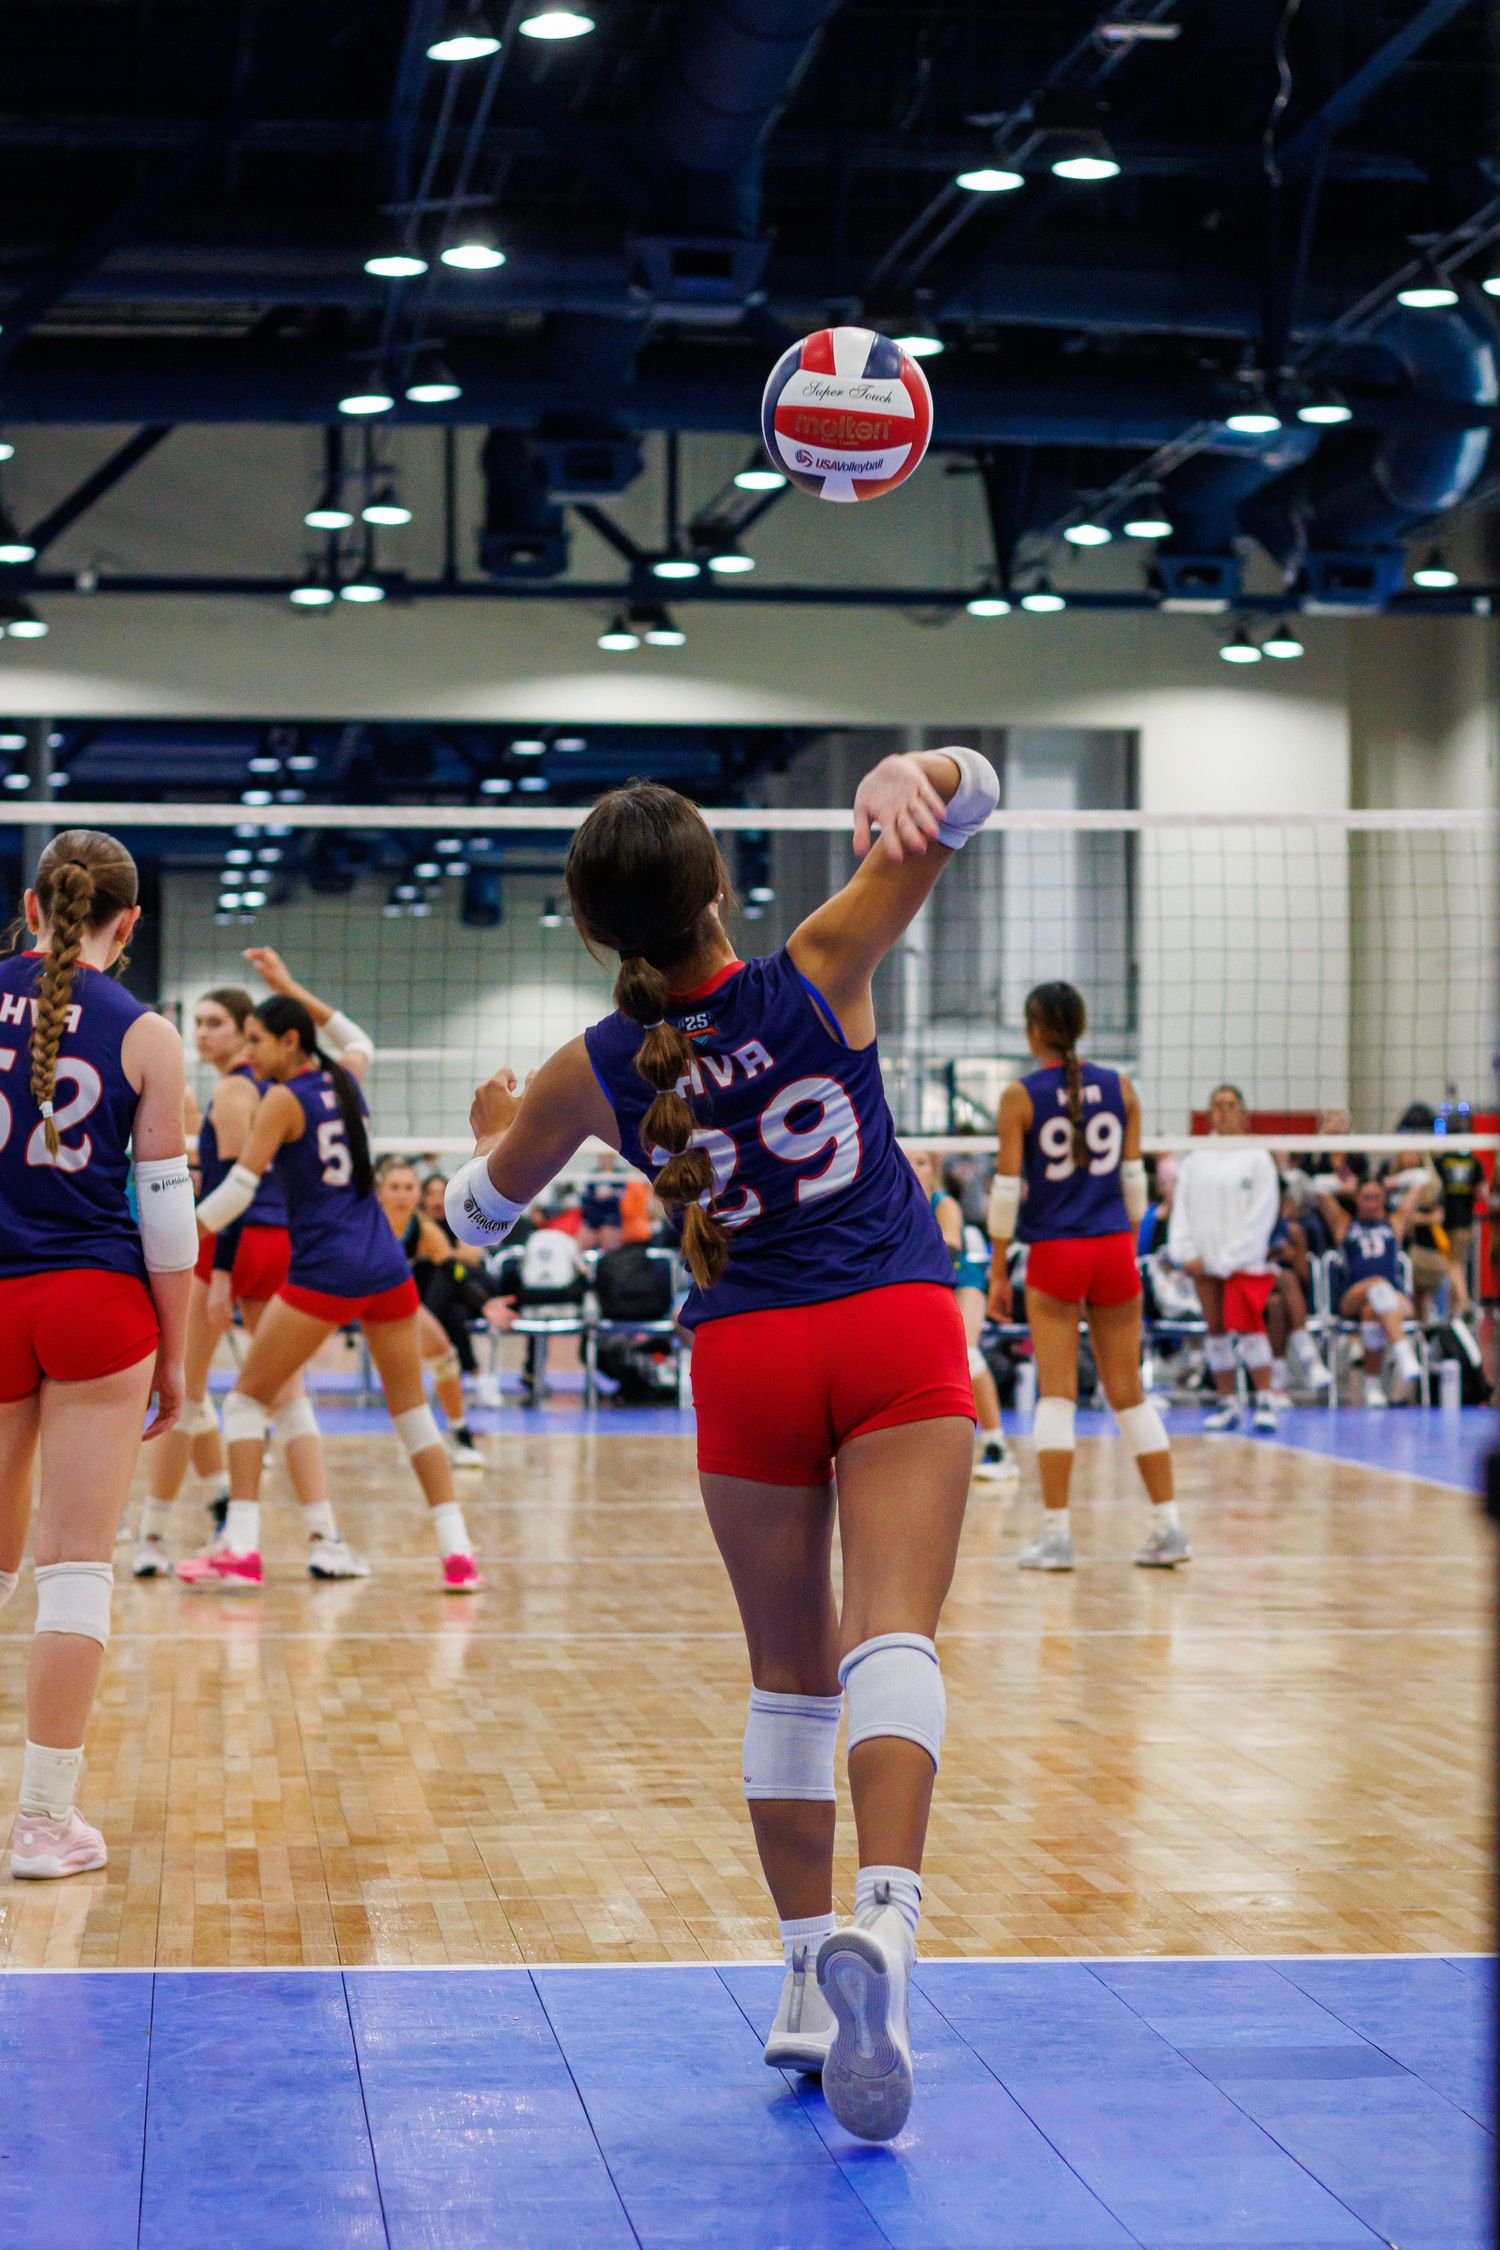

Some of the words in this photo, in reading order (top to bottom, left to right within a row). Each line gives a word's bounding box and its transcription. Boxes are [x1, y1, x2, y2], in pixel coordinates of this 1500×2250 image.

[802, 380, 844, 401] Super
[849, 383, 893, 404] Touch
[795, 414, 889, 440] molten
[685, 1013, 709, 1031] 25
[1039, 1111, 1122, 1181] 99
